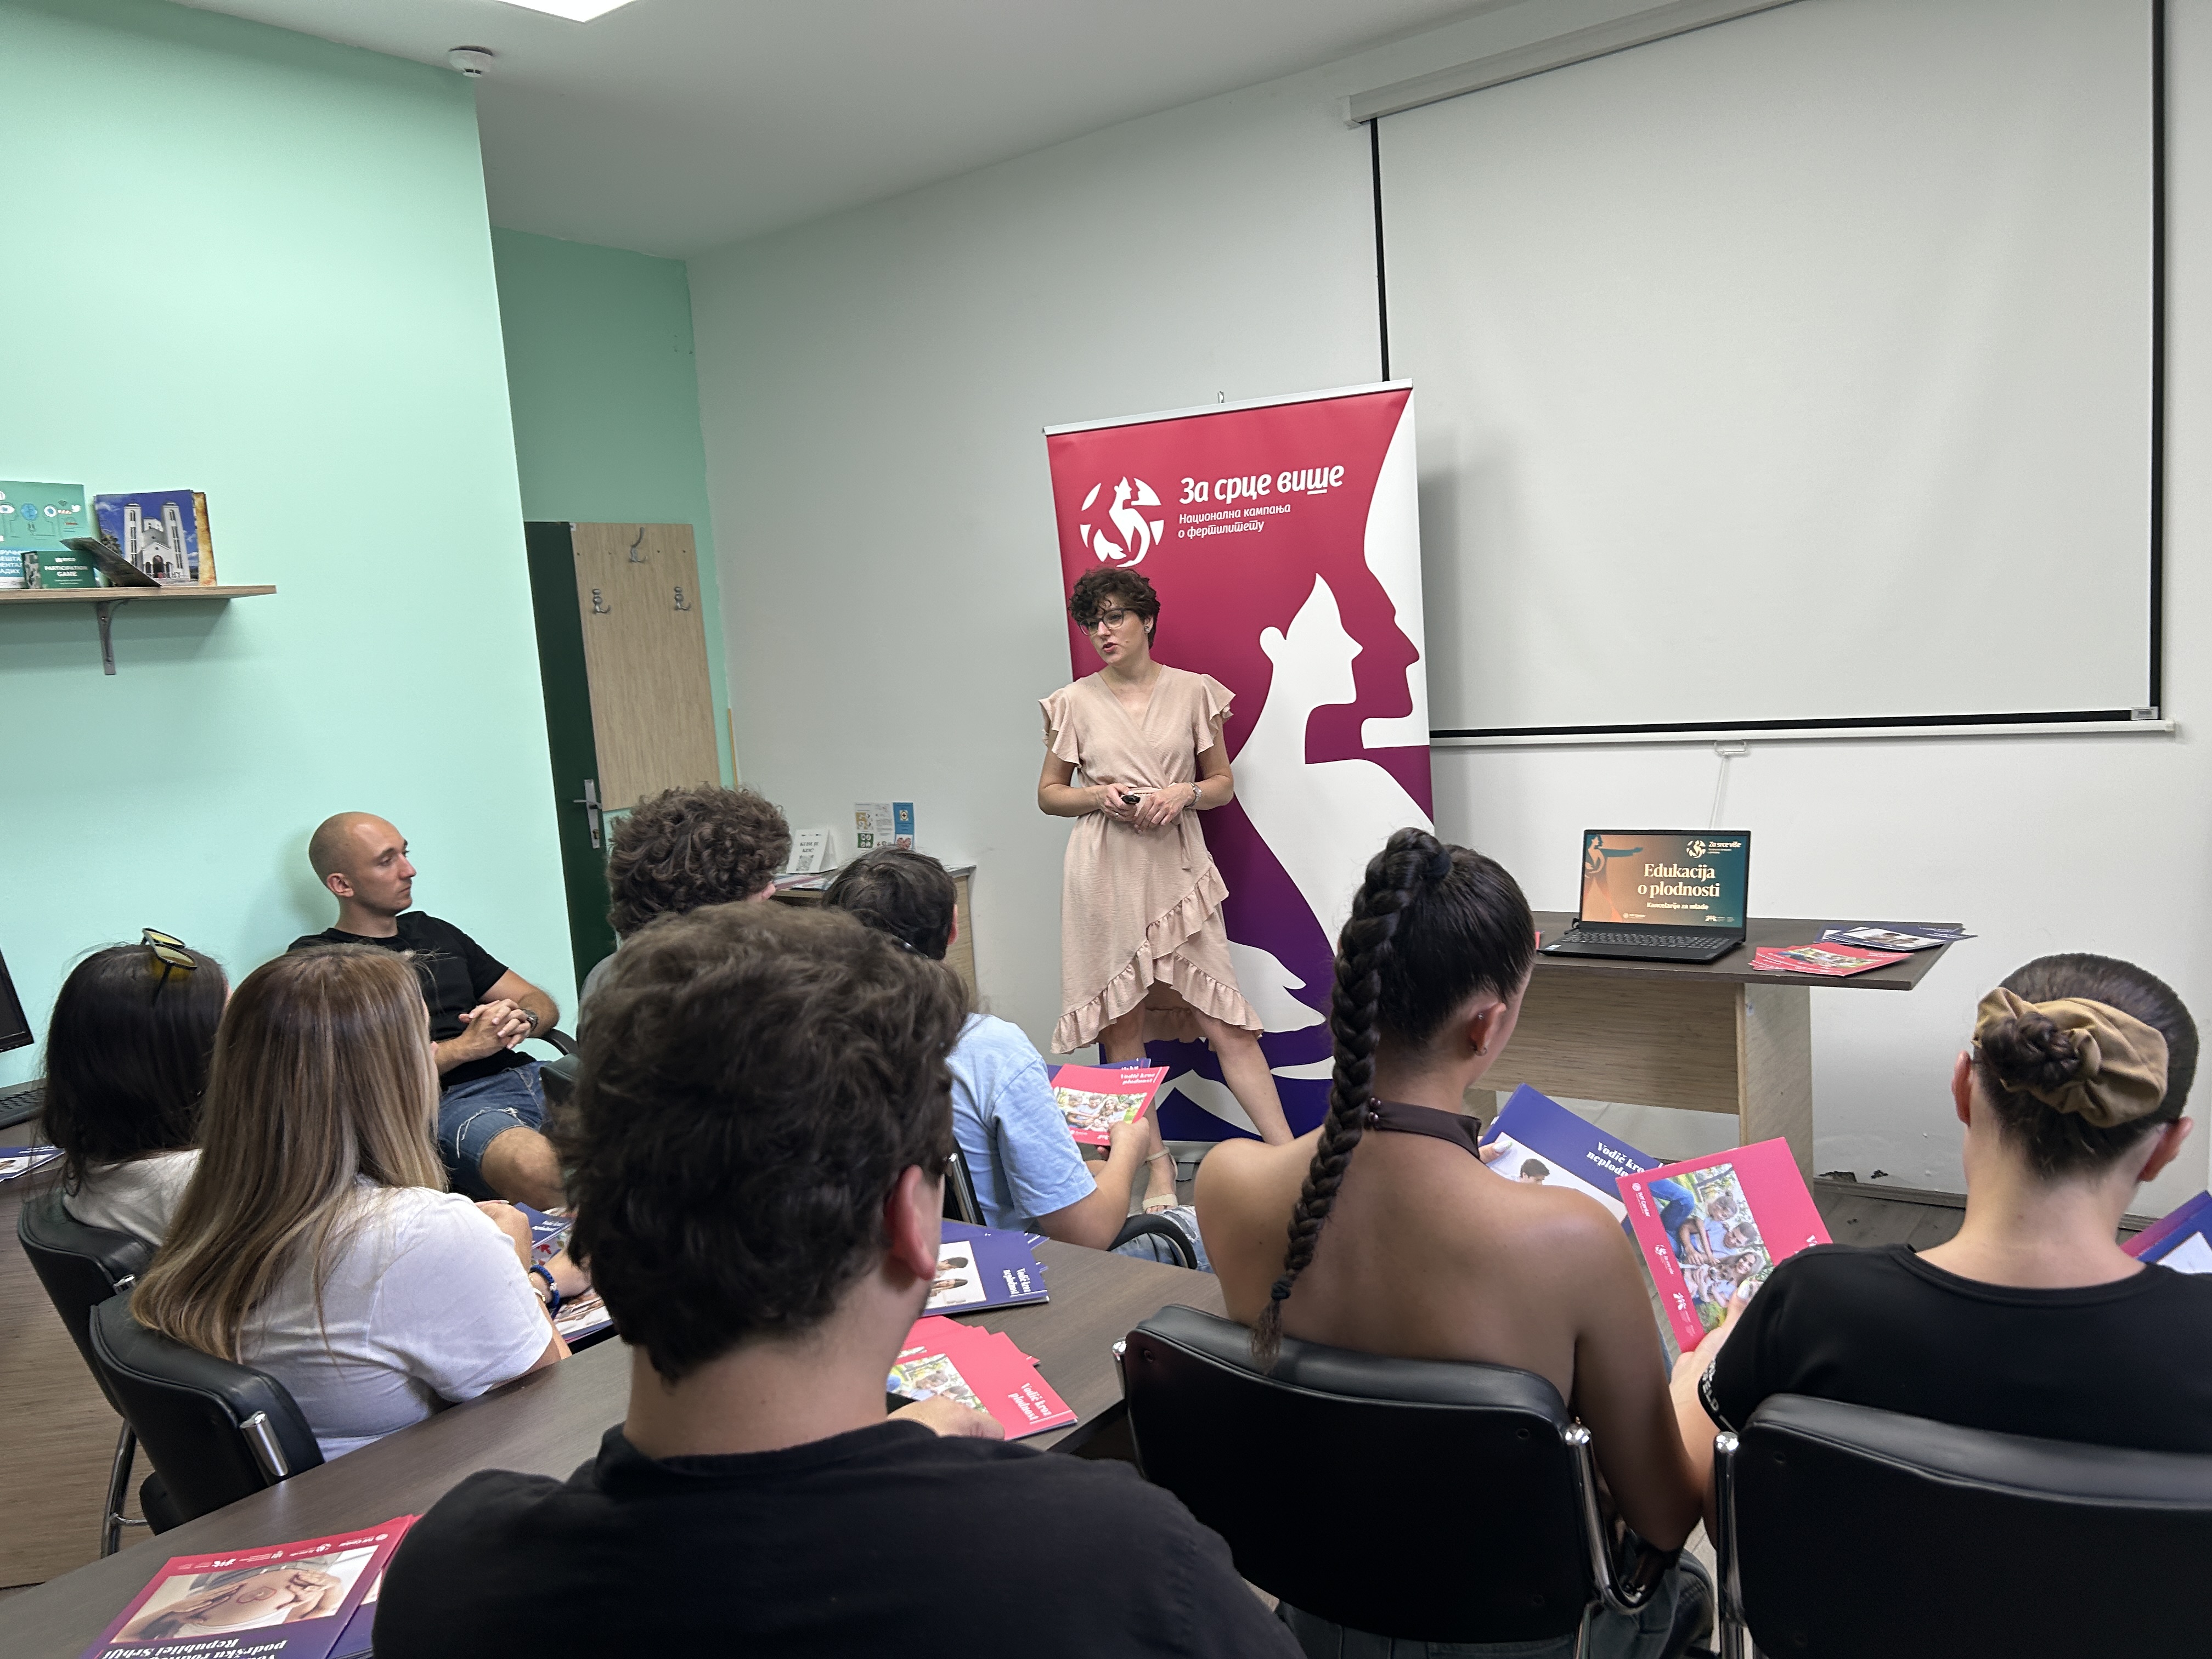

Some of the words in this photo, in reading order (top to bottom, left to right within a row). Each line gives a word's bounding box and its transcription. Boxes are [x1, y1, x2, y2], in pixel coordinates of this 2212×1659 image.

[1180, 477, 1209, 504] За
[1214, 473, 1272, 504] срце
[1277, 465, 1344, 495] више
[1179, 509, 1240, 524] Национална
[1243, 504, 1291, 517] кампања
[1178, 529, 1185, 538] о
[1187, 520, 1265, 539] фертилитету
[1644, 863, 1716, 882] Edukacija
[1638, 884, 1647, 895] o
[1650, 881, 1720, 898] plodnosti
[1586, 1152, 1629, 1177] neplodn
[1598, 1142, 1627, 1163] Vodič
[1625, 1158, 1645, 1173] kro
[1008, 1393, 1039, 1420] plodnost
[1021, 1383, 1043, 1401] Vodič
[1034, 1400, 1052, 1417] kroz
[154, 1639, 240, 1657] Republici
[213, 1640, 288, 1658] podršku
